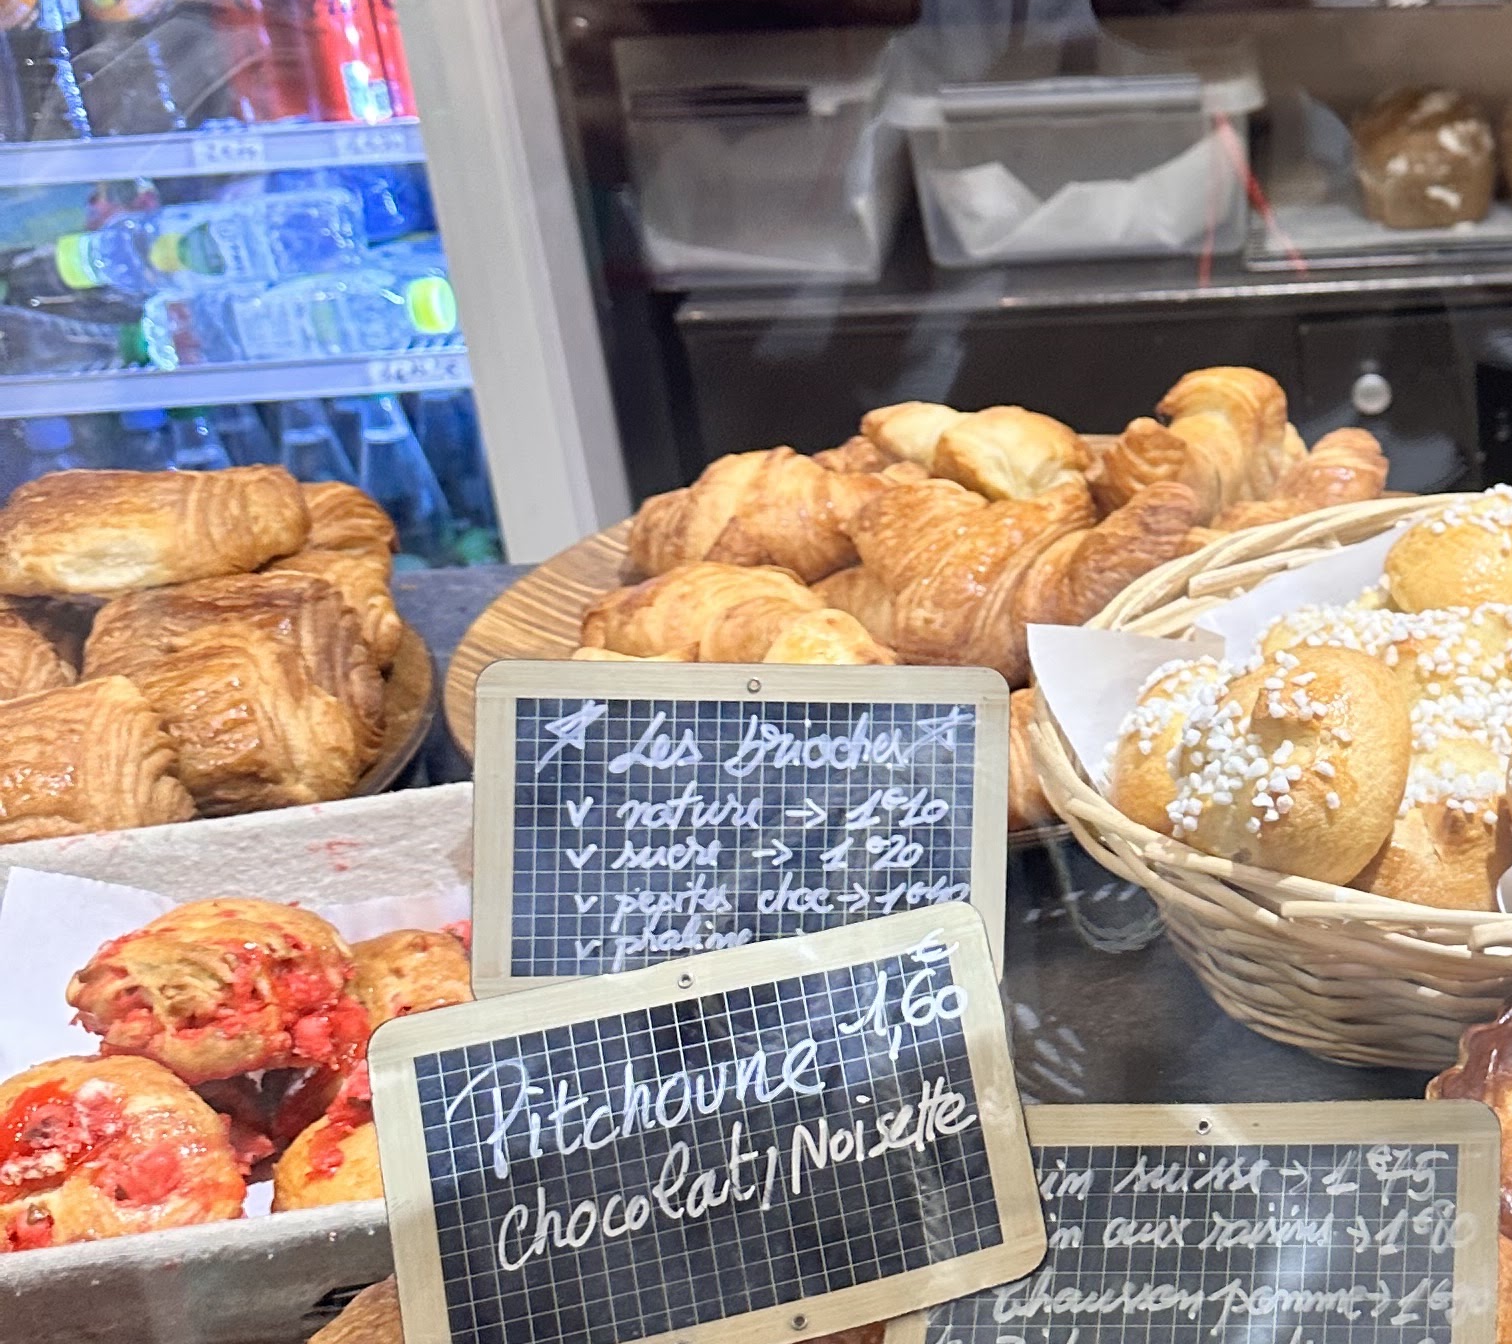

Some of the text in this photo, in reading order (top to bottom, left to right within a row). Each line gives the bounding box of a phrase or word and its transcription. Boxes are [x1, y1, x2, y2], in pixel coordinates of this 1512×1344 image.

[609, 711, 906, 777] Les brioches
[617, 780, 763, 830] nature
[757, 872, 834, 913] choc
[446, 1039, 825, 1179] Pitchoune
[1114, 1151, 1269, 1195] suisse
[1103, 1214, 1190, 1248] aux
[1200, 1203, 1334, 1252] raisins
